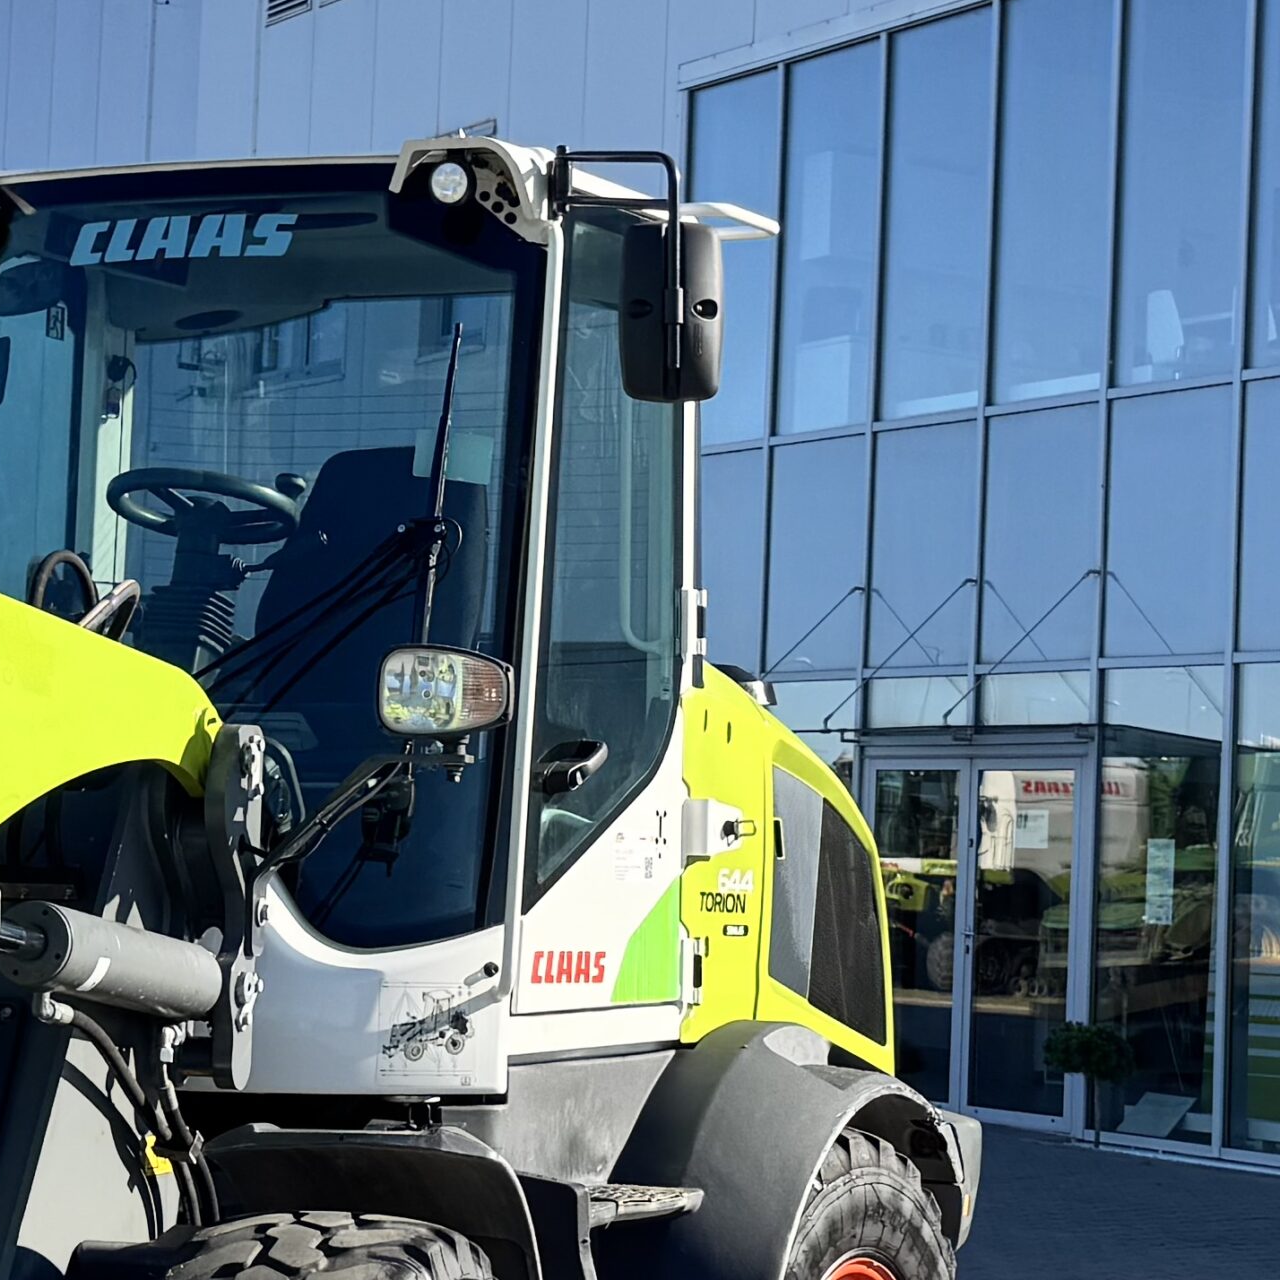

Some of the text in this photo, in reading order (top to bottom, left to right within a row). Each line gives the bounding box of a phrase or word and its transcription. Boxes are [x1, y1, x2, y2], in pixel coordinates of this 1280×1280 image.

[69, 213, 299, 267] CLAAS
[699, 891, 747, 914] TORION
[530, 950, 607, 984] CLAAS
